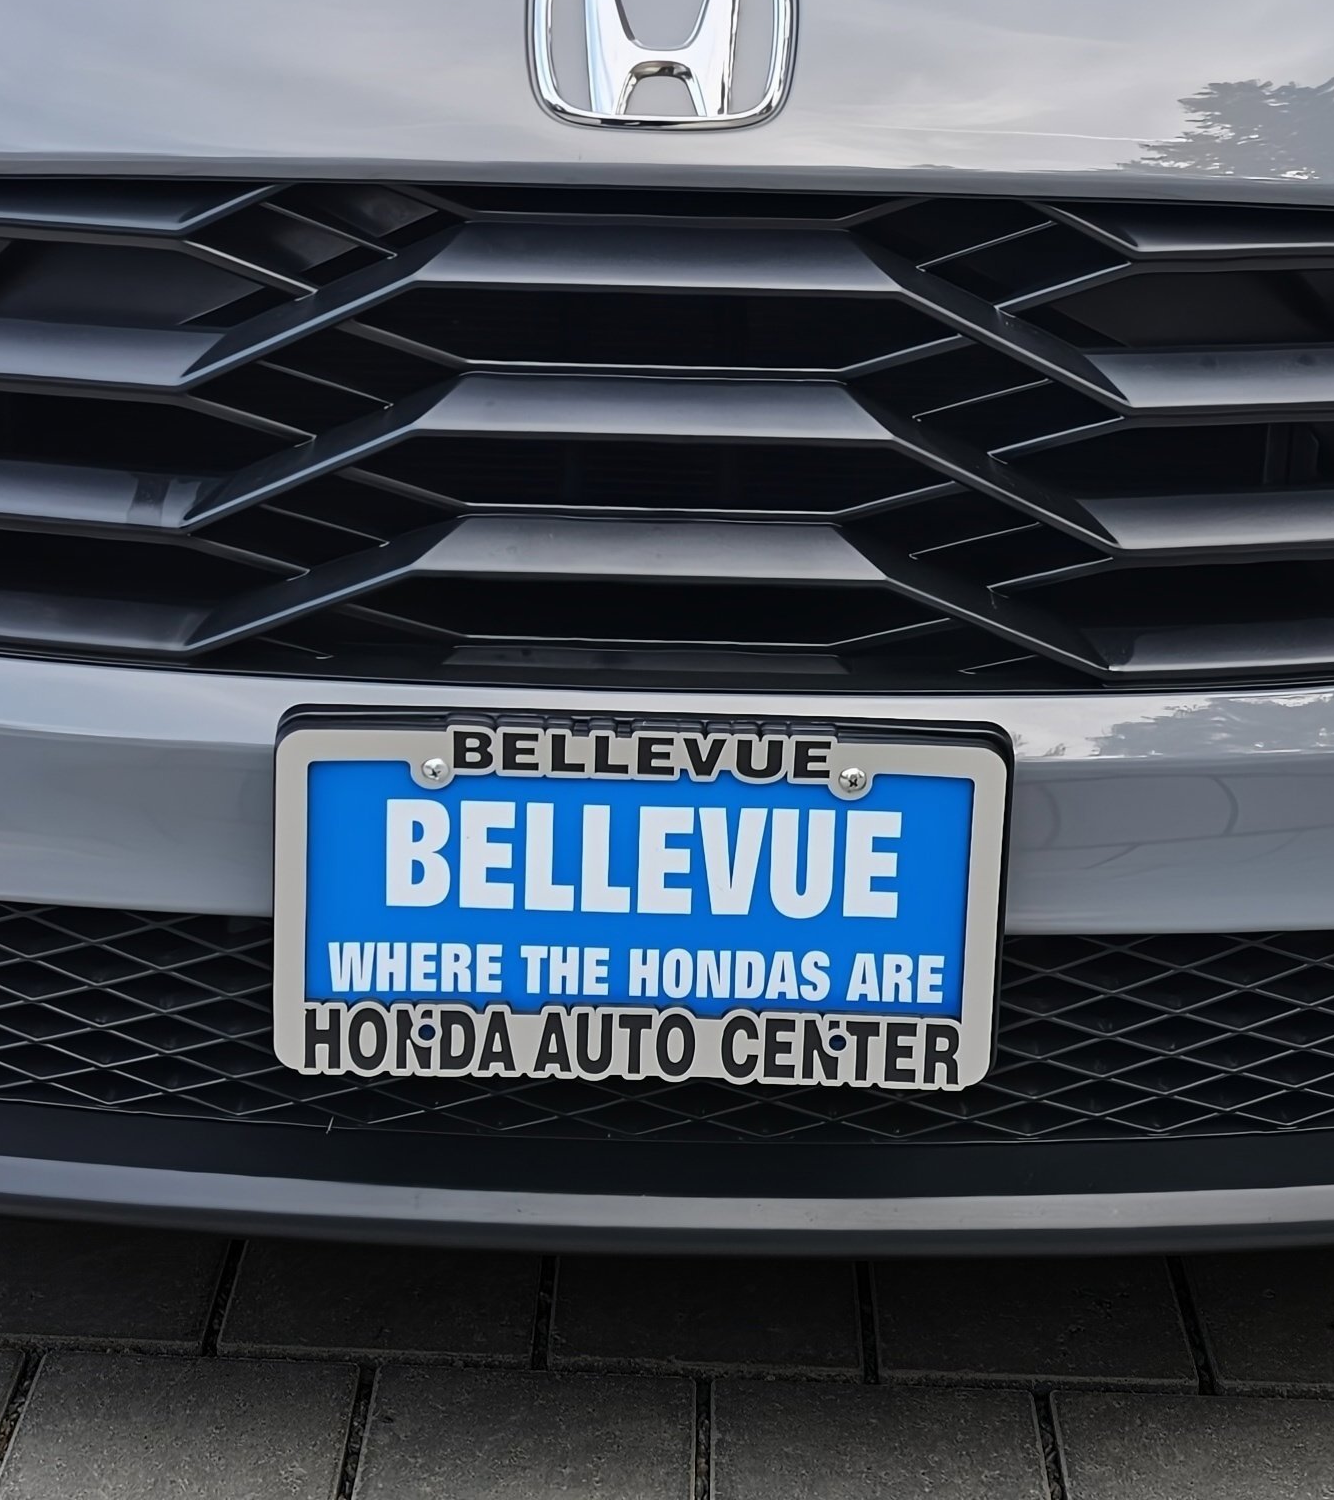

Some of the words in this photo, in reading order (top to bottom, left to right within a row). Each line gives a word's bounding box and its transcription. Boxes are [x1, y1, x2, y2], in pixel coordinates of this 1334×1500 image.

[453, 731, 832, 780] BELLEVUE
[386, 799, 903, 920] BELLEVUE
[328, 942, 503, 993] WHERE
[521, 945, 610, 995] THE
[628, 948, 831, 1001] HONDAS
[846, 953, 945, 1003] ARE
[304, 1007, 516, 1070] HONDA
[533, 1012, 696, 1077] AUTO
[721, 1015, 959, 1085] CENTER
